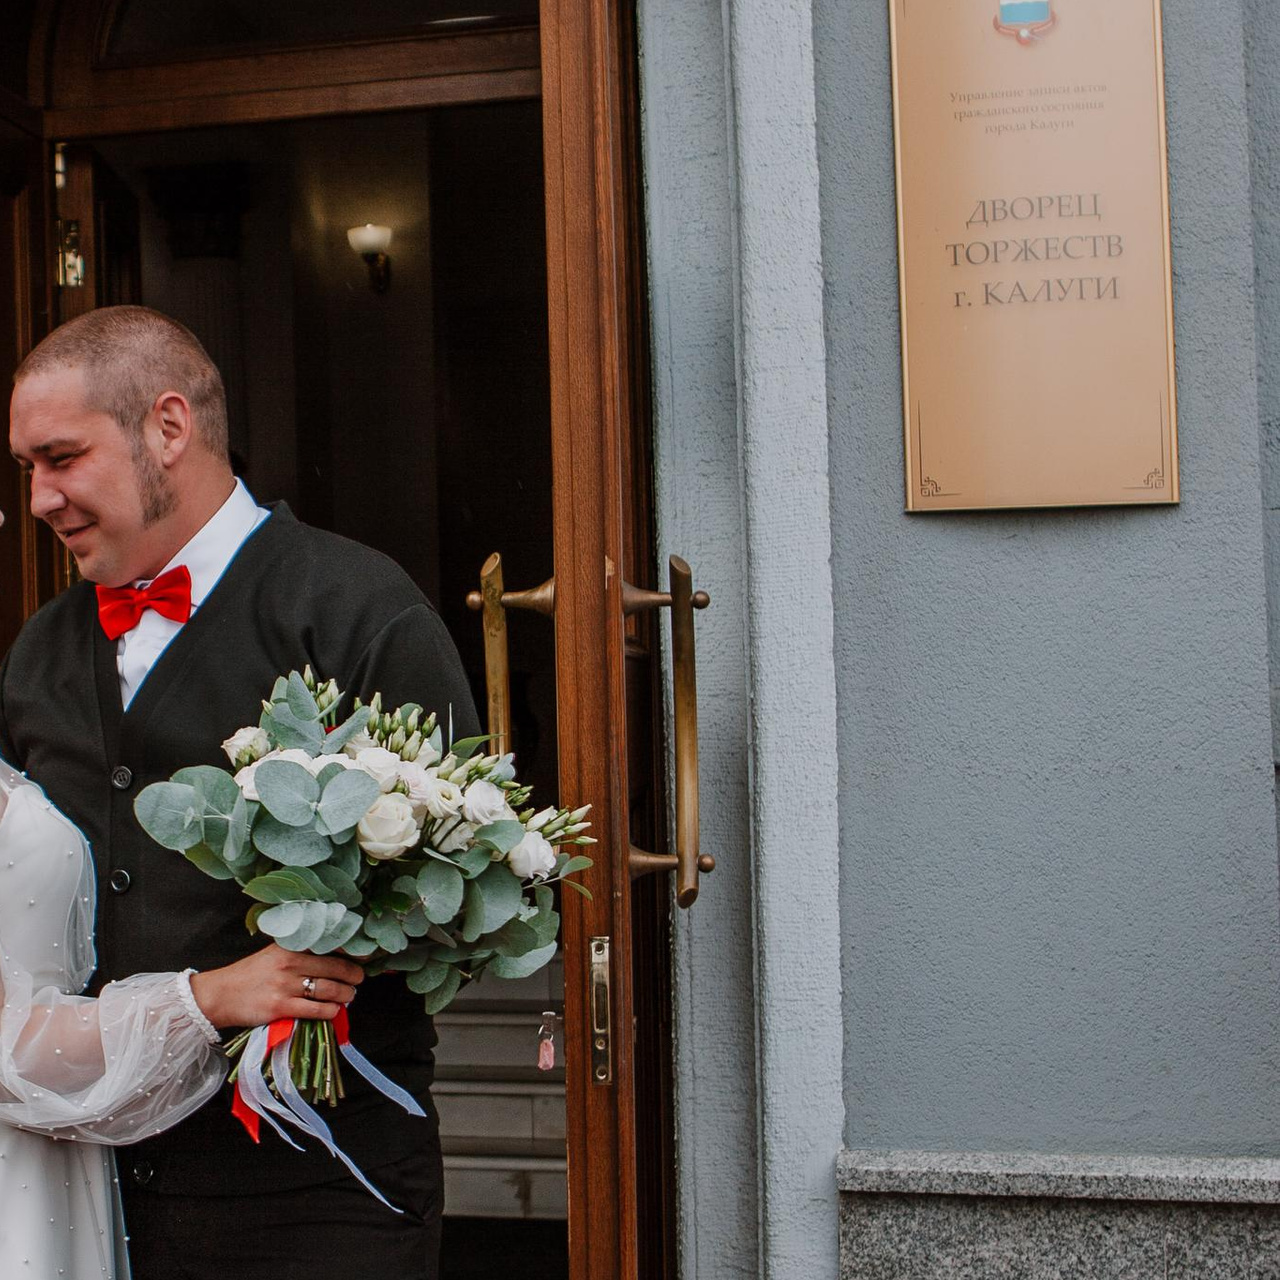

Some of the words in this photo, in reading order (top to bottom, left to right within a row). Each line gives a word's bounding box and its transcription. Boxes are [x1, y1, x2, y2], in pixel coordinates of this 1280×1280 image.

[966, 193, 1102, 229] ДВОРЕЦ
[945, 234, 1125, 267] ТОРЖЕСТВ
[982, 276, 1121, 306] КАЛУГИ
